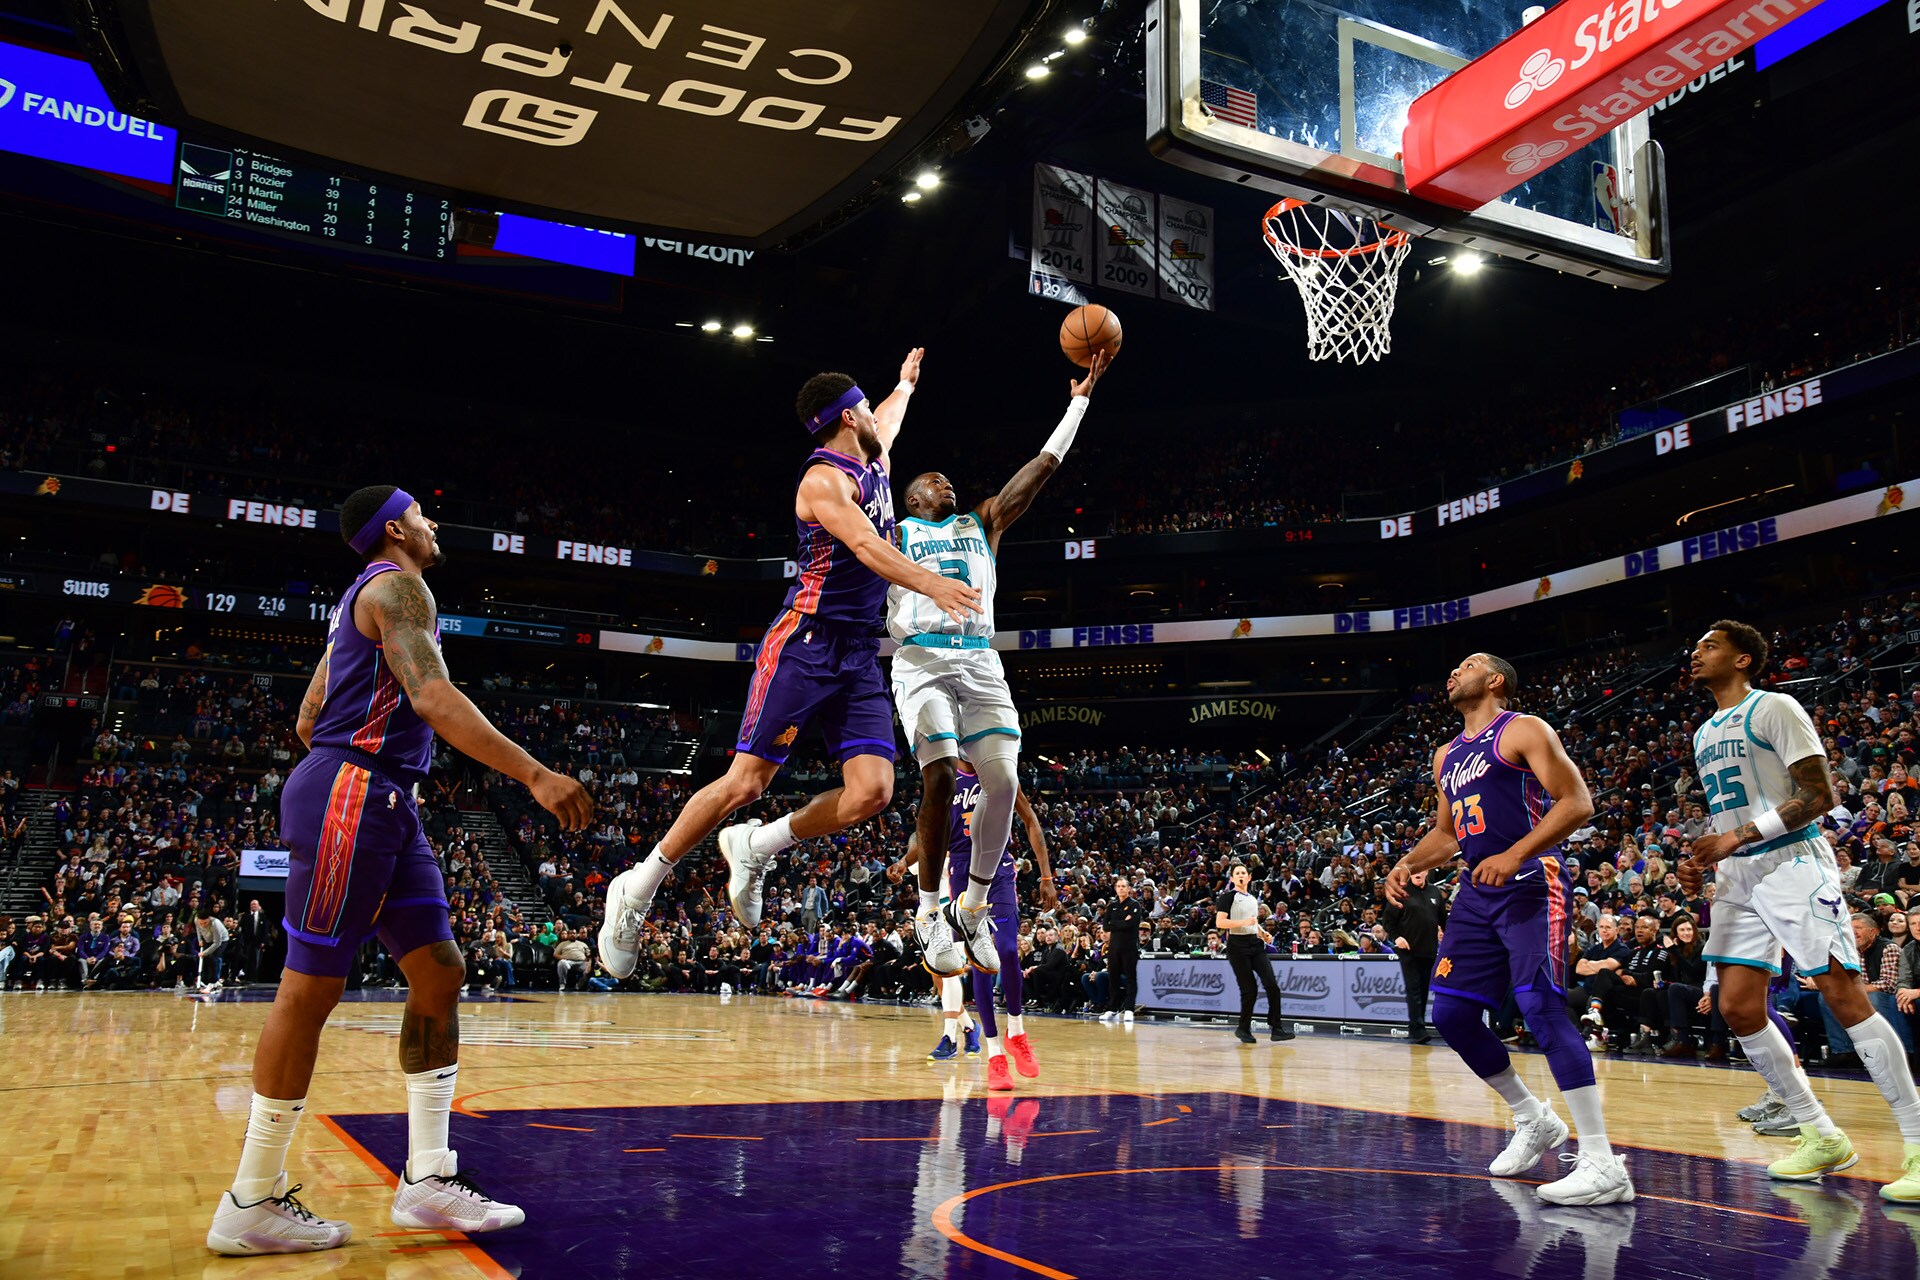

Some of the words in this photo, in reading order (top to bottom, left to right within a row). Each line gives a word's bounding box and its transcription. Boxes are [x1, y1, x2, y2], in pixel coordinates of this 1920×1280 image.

[1570, 0, 1682, 71] Stat
[22, 91, 164, 141] FANDUEL
[182, 177, 225, 195] HORNETS
[234, 170, 243, 180] 3
[250, 173, 287, 189] Rozier
[325, 188, 340, 199] 39
[368, 198, 376, 207] 4
[404, 205, 412, 215] 8
[251, 160, 294, 178] Bridges
[329, 176, 341, 187] 11
[369, 185, 377, 195] 6
[406, 193, 414, 202] 5
[440, 200, 449, 209] 2
[228, 195, 243, 206] 24
[247, 198, 278, 213] Miller
[323, 213, 338, 224] 20
[367, 223, 373, 232] 1
[402, 230, 411, 239] 2
[438, 236, 446, 246] 3
[231, 182, 244, 193] 11
[248, 185, 284, 201] Martin
[326, 202, 338, 212] 11
[367, 210, 375, 220] 3
[405, 218, 411, 227] 1
[440, 225, 446, 233] 1
[1103, 206, 1148, 223] CHAMPIONS
[227, 208, 242, 219] 25
[246, 211, 311, 233] Washington
[322, 227, 336, 237] 13
[365, 235, 373, 245] 3
[401, 242, 409, 252] 4
[437, 248, 445, 258] 3
[1165, 220, 1208, 237] CHAMPIONS
[1040, 248, 1084, 274] 2014
[1042, 281, 1061, 297] 29
[1104, 265, 1148, 288] 2009
[1655, 421, 1692, 456] DE
[1726, 379, 1823, 434] FENSE
[150, 489, 191, 514] DE
[227, 499, 318, 529] FENSE
[1380, 515, 1413, 540] DE
[1437, 487, 1501, 527] FENSE
[492, 532, 526, 555] DE
[556, 540, 632, 567] FENSE
[909, 537, 985, 562] CHARLOTTE
[1064, 540, 1097, 560] DE
[1625, 548, 1660, 578] DE
[1682, 518, 1778, 565] FENSE
[783, 560, 799, 580] D
[205, 592, 237, 613] 129
[257, 595, 286, 612] 2:16
[1334, 611, 1370, 634] DE
[1393, 598, 1471, 630] FENSE
[575, 632, 593, 645] 20
[1019, 629, 1052, 649] DE
[1073, 624, 1154, 647] FENSE
[255, 676, 270, 685] 120
[1020, 705, 1102, 729] JAMESON
[1188, 699, 1277, 725] JAMESON
[1702, 765, 1750, 815] 25
[1451, 793, 1486, 842] 23
[1151, 964, 1183, 987] Sweet
[1183, 965, 1223, 989] James
[1280, 967, 1328, 993] James
[1351, 966, 1399, 994] Sweet
